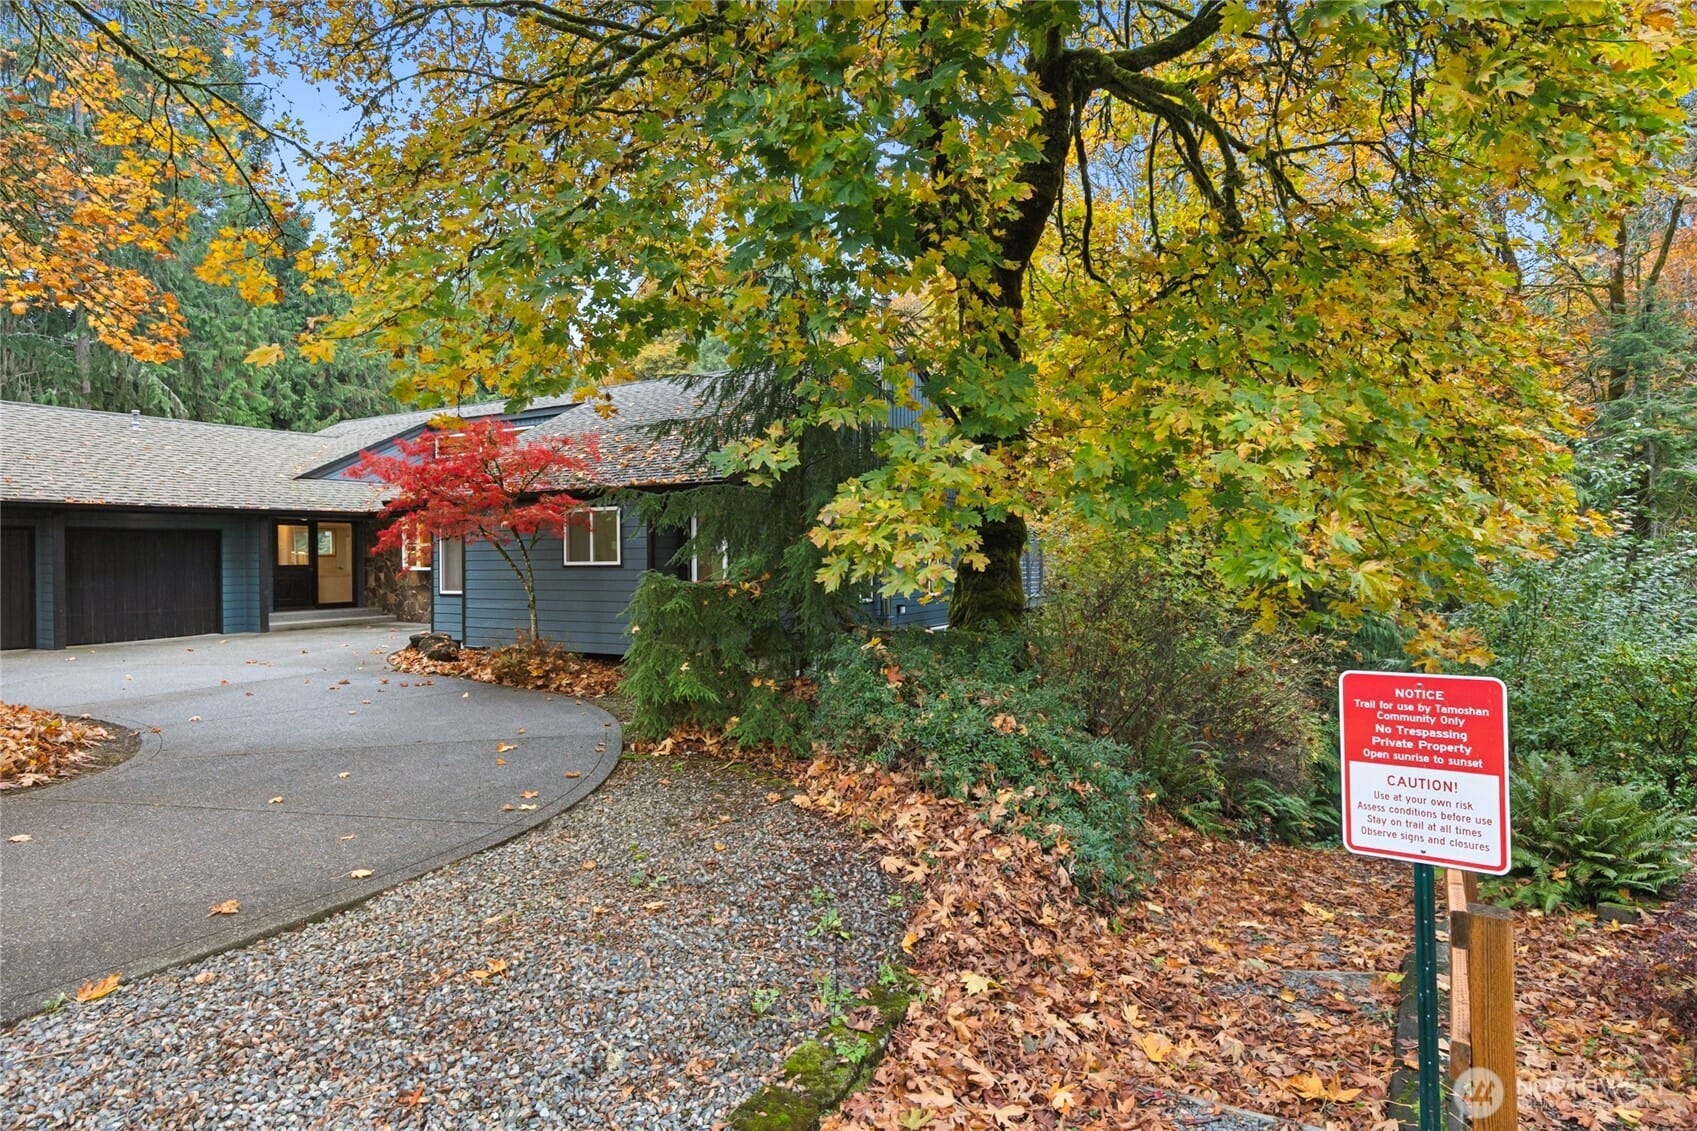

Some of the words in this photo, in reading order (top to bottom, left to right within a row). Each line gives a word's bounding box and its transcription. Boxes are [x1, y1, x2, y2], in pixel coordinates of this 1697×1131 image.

[1395, 689, 1444, 700] NOTICE
[1355, 699, 1375, 709] Trail
[1380, 701, 1393, 710] for
[1418, 703, 1431, 714] by
[1435, 705, 1489, 716] Tamoshan
[1377, 712, 1436, 724] Community
[1440, 716, 1465, 727] Only
[1376, 724, 1391, 734] No
[1397, 727, 1467, 742] Trespassing
[1372, 737, 1413, 749] Private
[1419, 741, 1472, 755] Property
[1363, 749, 1389, 761] Open
[1393, 753, 1429, 763] sunrise
[1448, 759, 1483, 768] sunset
[1388, 776, 1458, 792] CAUTION!
[1374, 791, 1389, 800] Use
[1394, 794, 1402, 802] at
[1406, 796, 1426, 806] your
[1431, 799, 1451, 807] own
[1456, 800, 1473, 810] risk
[1358, 802, 1385, 812] Assess
[1389, 806, 1437, 819] conditions
[1441, 811, 1471, 823] before
[1476, 817, 1492, 826] use
[1368, 815, 1386, 828] Stay
[1391, 819, 1402, 827] on
[1406, 820, 1424, 830] trail
[1440, 824, 1451, 833] all
[1456, 826, 1482, 837] times
[1361, 827, 1397, 839] Observe
[1401, 831, 1424, 843] signs
[1428, 835, 1445, 845] and
[1450, 839, 1490, 852] closures
